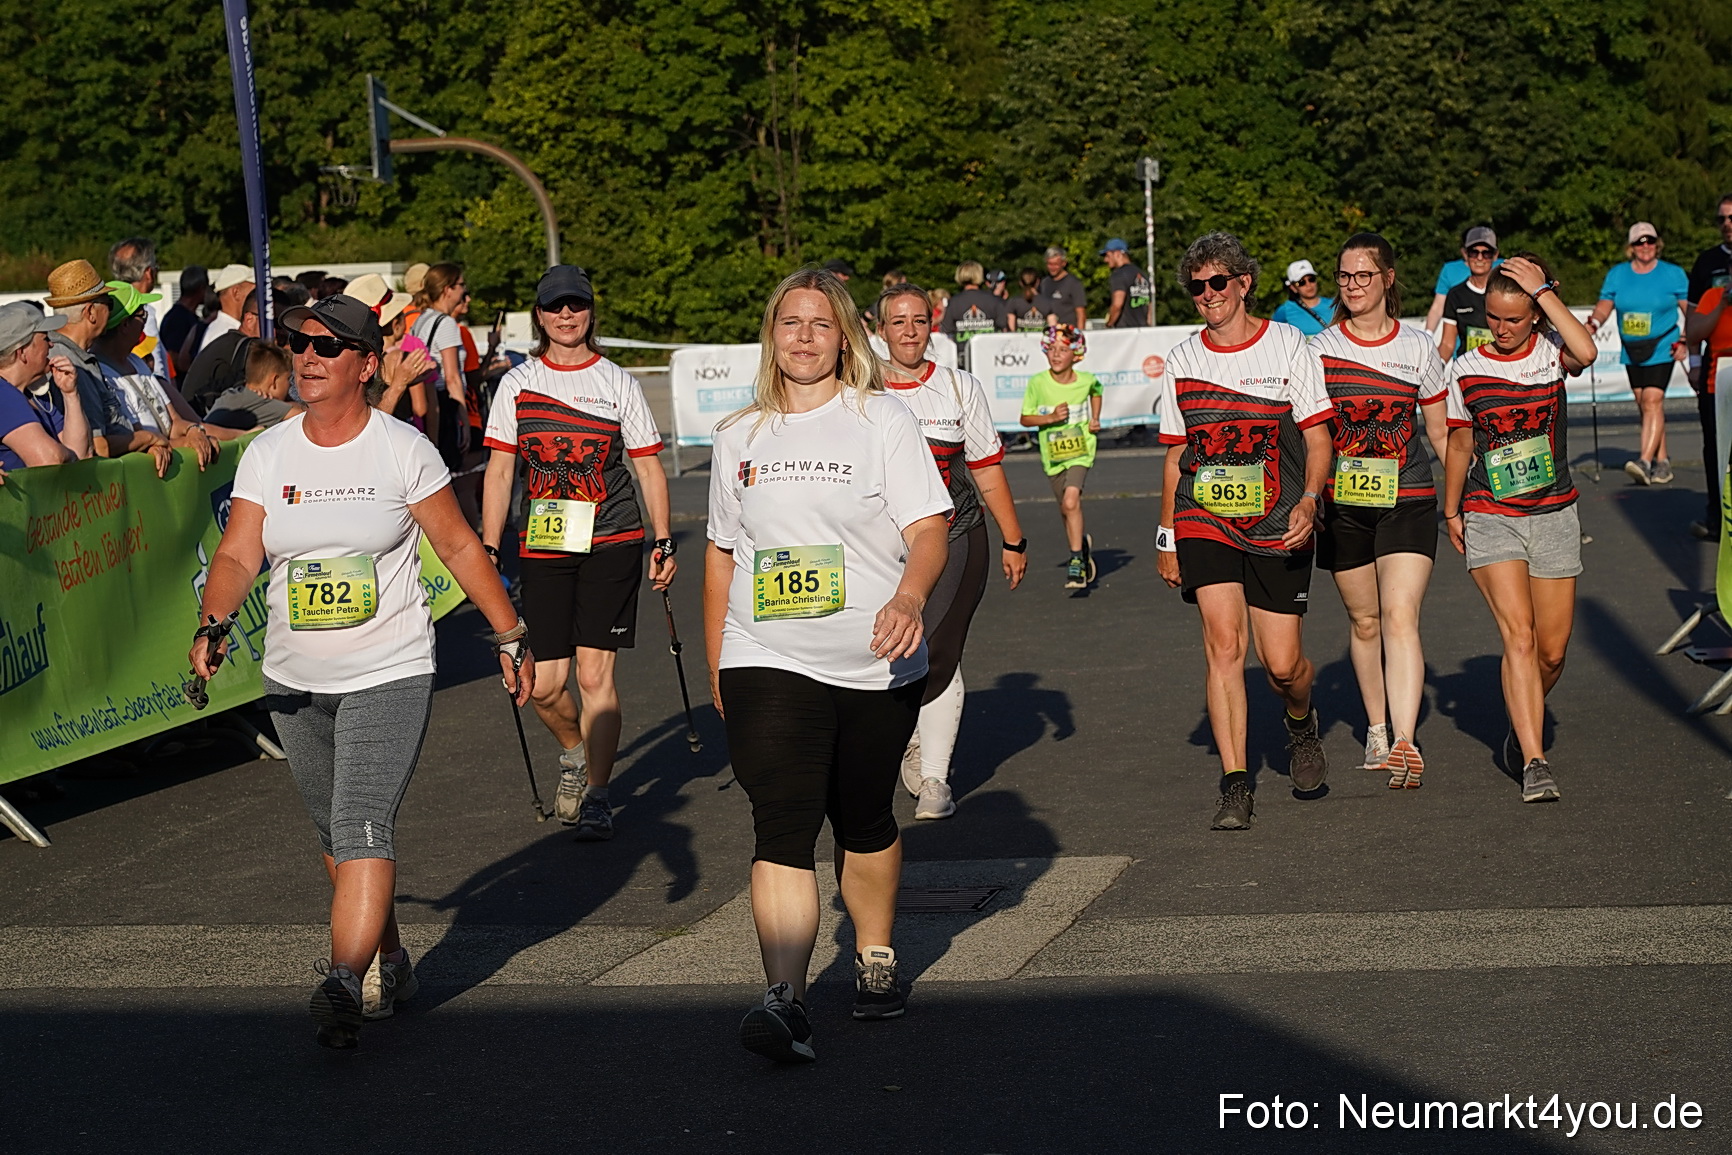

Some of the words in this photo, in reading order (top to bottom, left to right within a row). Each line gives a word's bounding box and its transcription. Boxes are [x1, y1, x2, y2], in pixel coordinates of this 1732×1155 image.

[995, 354, 1029, 367] NOW
[695, 366, 730, 381] NOW
[1239, 376, 1282, 386] NEUMARKT
[1053, 437, 1080, 452] 1431
[759, 460, 853, 475] SCHWARZ
[1505, 455, 1540, 479] 194
[1543, 454, 1554, 478] 2022
[758, 475, 806, 485] COMPUTER
[809, 475, 852, 485] SYSTEME
[1336, 474, 1344, 498] WALK
[1349, 474, 1382, 491] 125
[1492, 472, 1502, 491] RUN
[1525, 473, 1541, 482] Vera
[304, 487, 376, 498] SCHWARZ
[1210, 483, 1248, 501] 963
[1254, 484, 1262, 509] 2022
[1344, 490, 1365, 498] Fromm
[1365, 491, 1386, 499] Hanna
[26, 490, 82, 554] Gesunde
[81, 482, 128, 524] Firmen
[529, 518, 537, 543] WALK
[54, 540, 104, 593] laufen
[101, 509, 148, 573] länger!
[773, 569, 820, 596] 185
[830, 571, 840, 605] 2022
[304, 581, 352, 606] 782
[362, 583, 372, 614] 2022
[757, 577, 765, 612] WALK
[764, 597, 791, 607] Barina
[791, 594, 831, 604] Christine
[291, 587, 300, 621] WALK
[302, 607, 335, 617] Taucher
[336, 605, 360, 615] Petra
